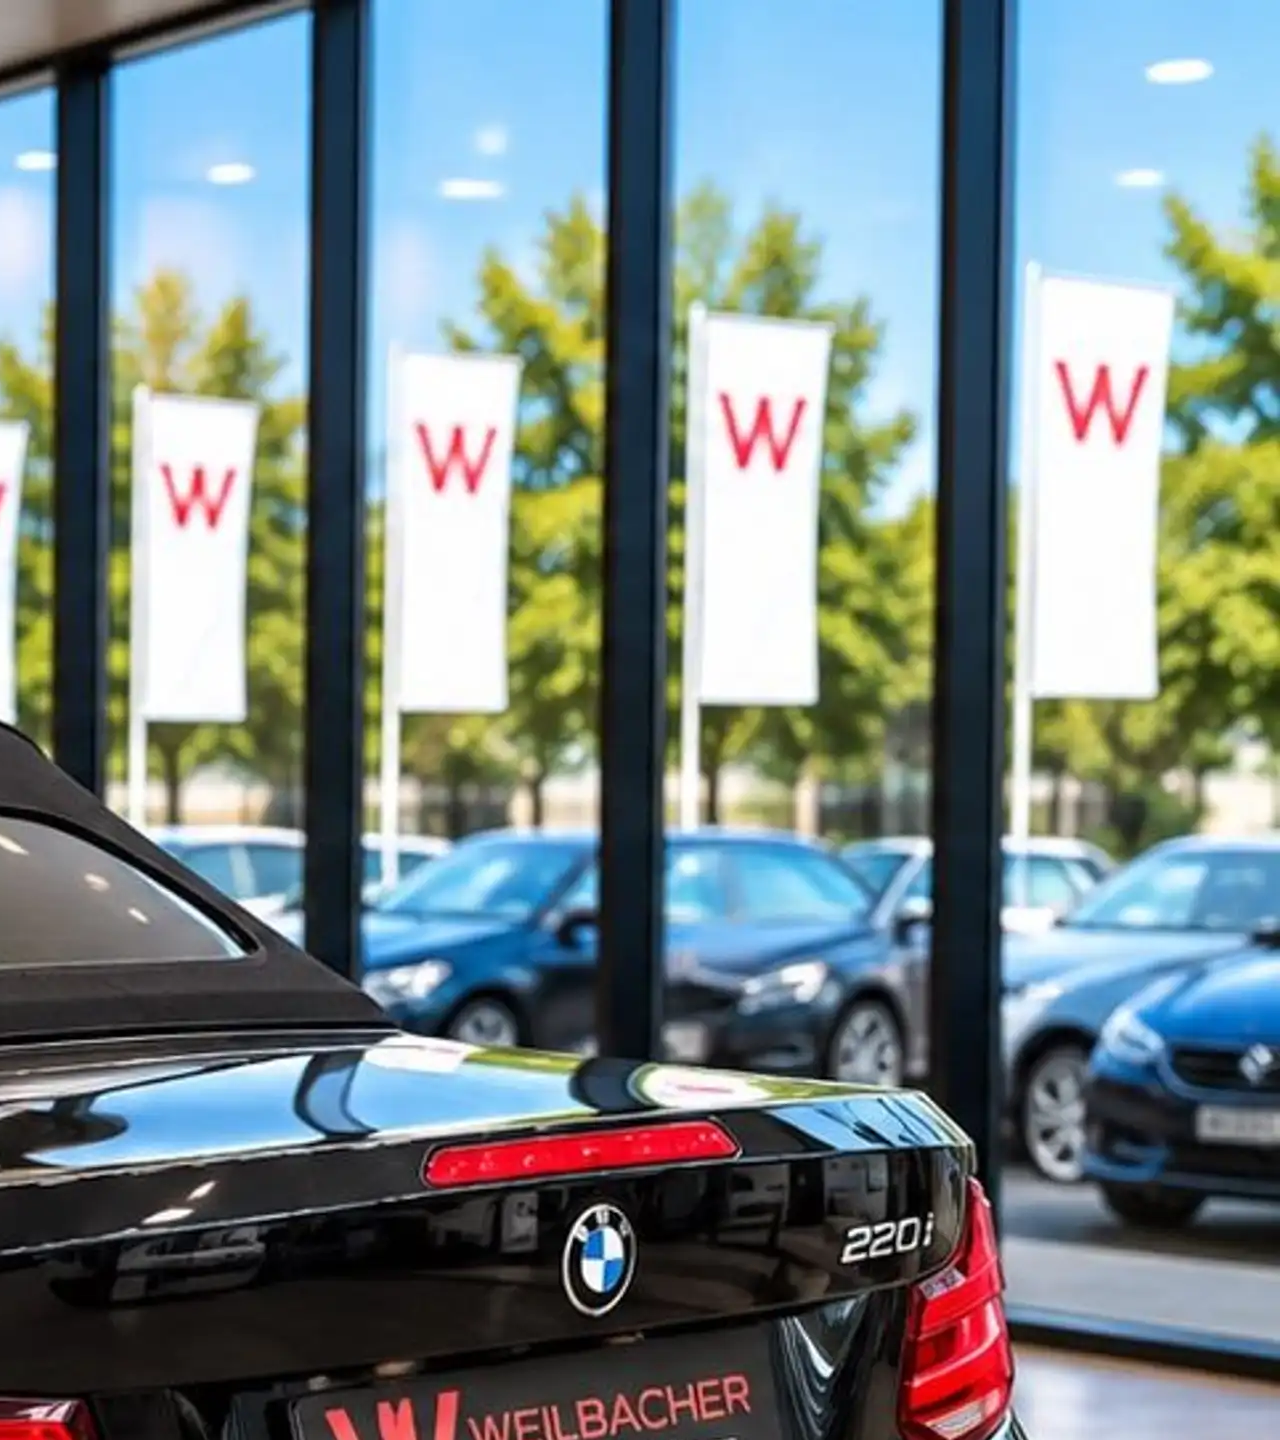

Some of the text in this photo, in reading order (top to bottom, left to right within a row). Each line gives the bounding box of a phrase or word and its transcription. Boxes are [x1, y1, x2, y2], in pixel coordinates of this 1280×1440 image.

[719, 392, 807, 473] W
[1054, 359, 1150, 448] W
[415, 423, 497, 496] W
[159, 464, 237, 531] W
[840, 1212, 934, 1264] 220i
